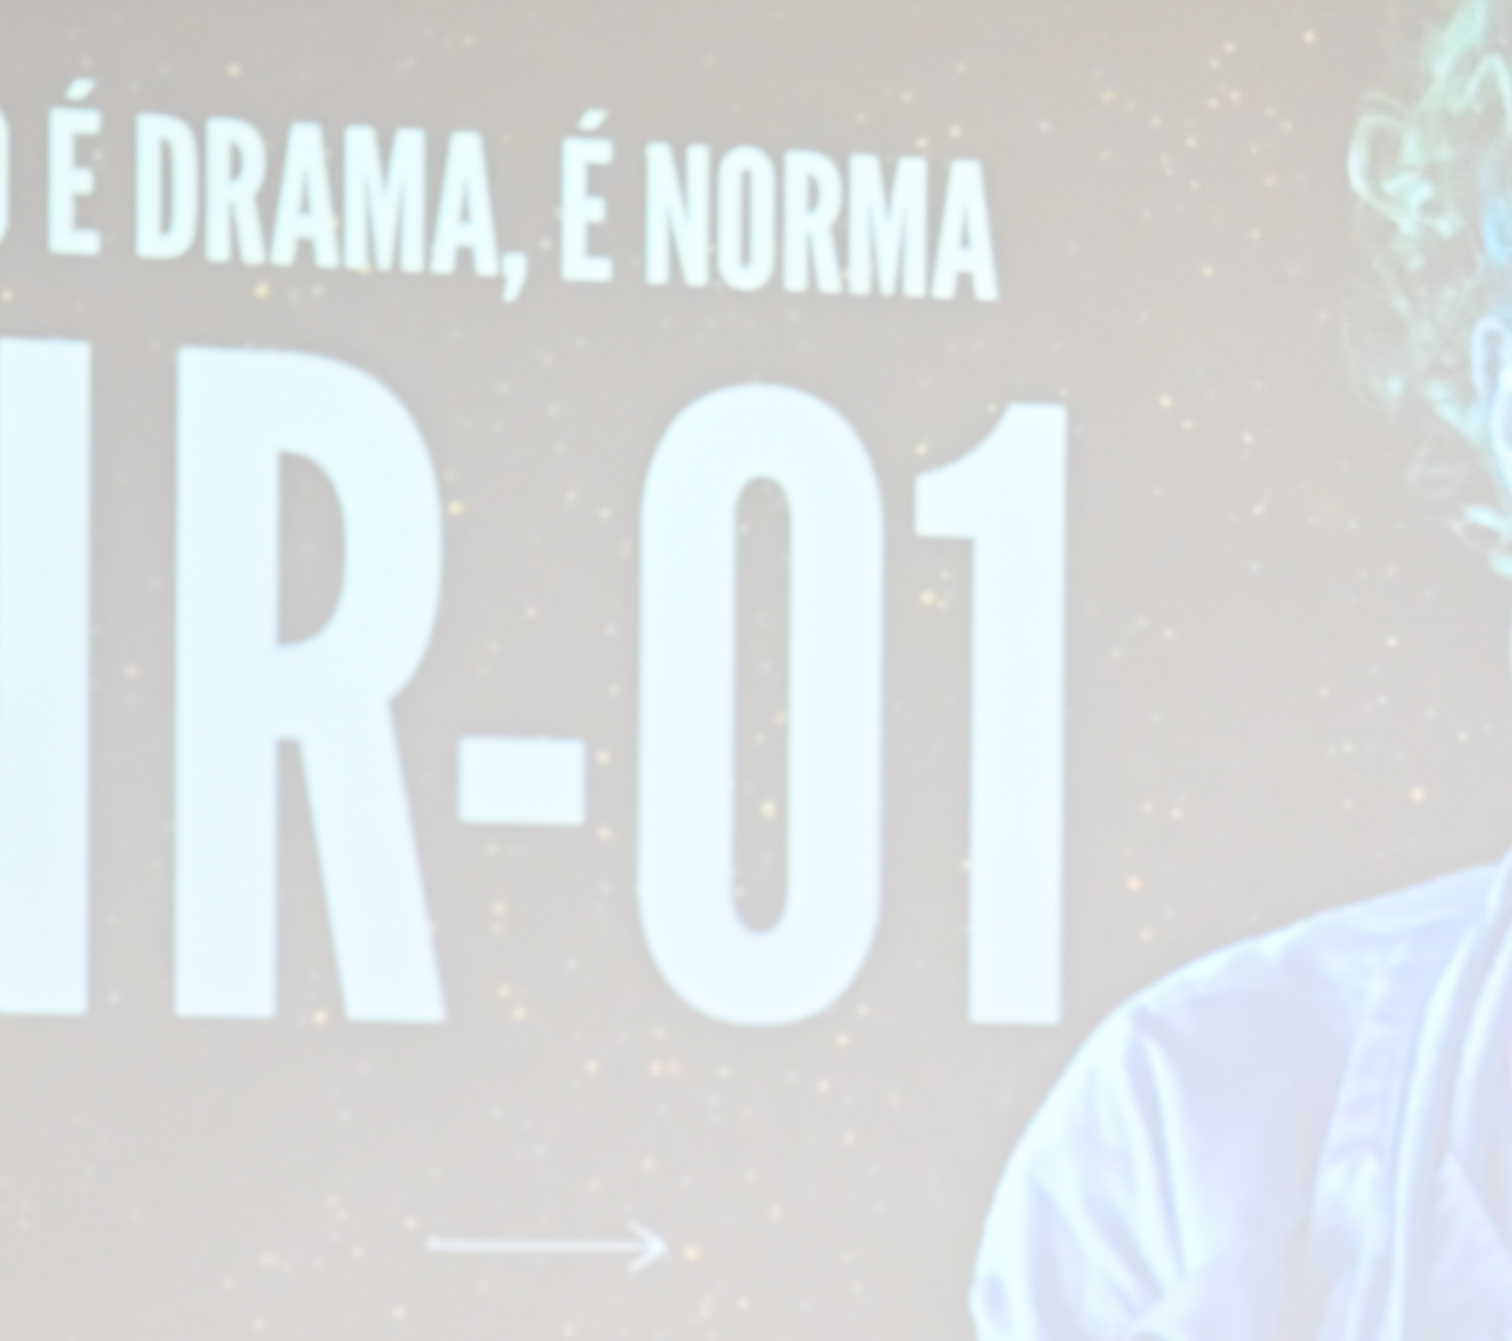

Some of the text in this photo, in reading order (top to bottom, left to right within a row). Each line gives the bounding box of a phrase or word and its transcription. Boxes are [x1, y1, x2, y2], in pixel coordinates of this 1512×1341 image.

[48, 79, 101, 256] É
[136, 113, 527, 302] DRAMA,
[560, 109, 614, 284] É
[645, 142, 1000, 302] NORMA
